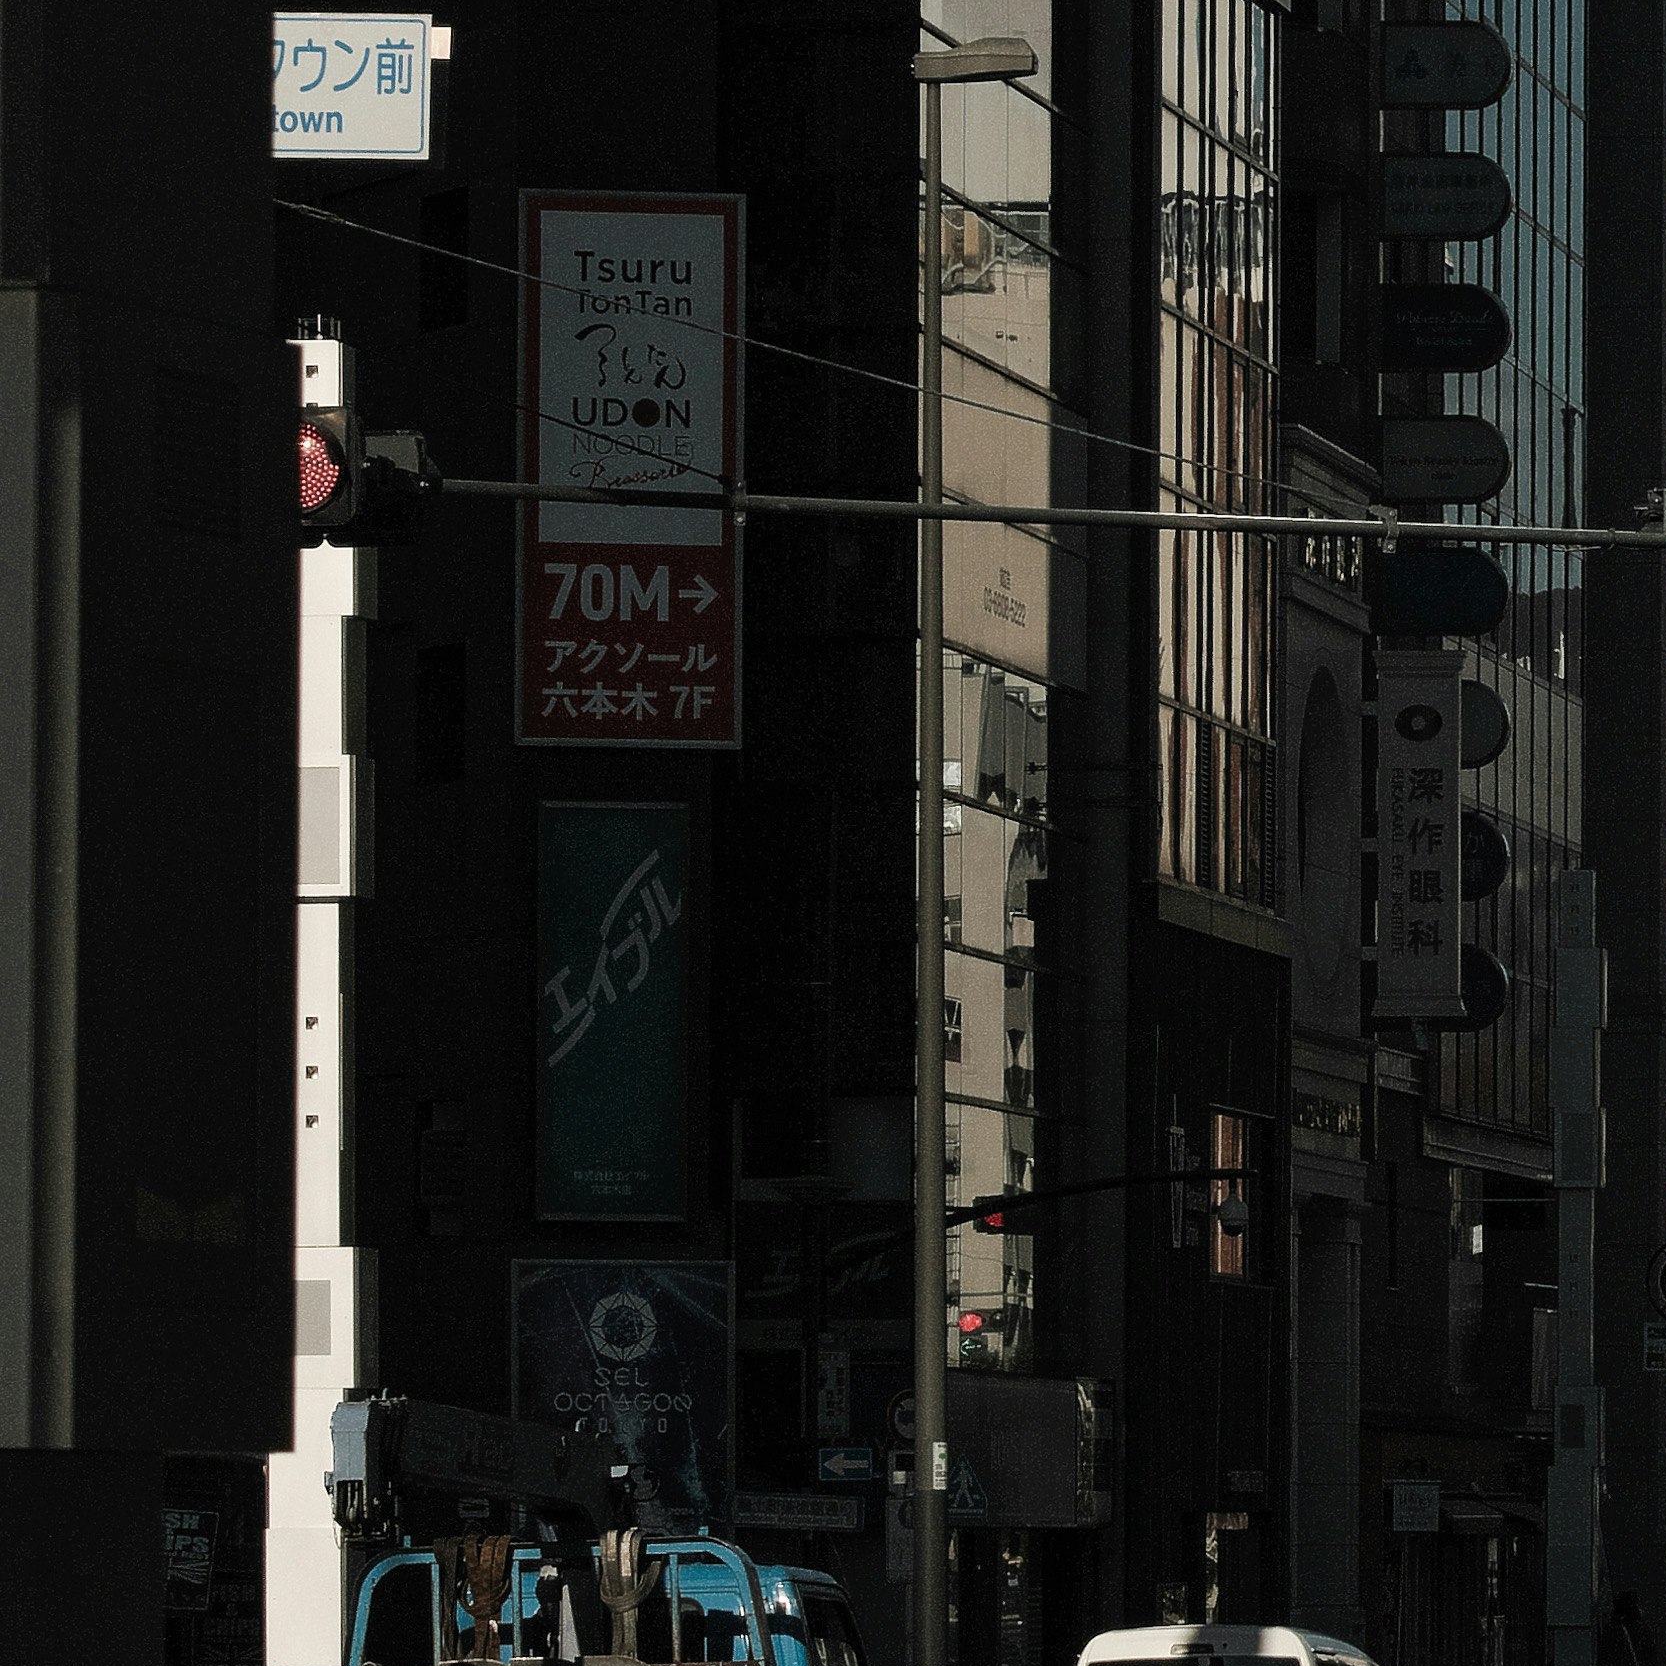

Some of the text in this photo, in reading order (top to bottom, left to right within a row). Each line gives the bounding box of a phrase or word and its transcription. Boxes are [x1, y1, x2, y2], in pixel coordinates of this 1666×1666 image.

[573, 250, 692, 285] Tsuru
[577, 289, 692, 317] TonTan
[572, 433, 692, 457] NOODLE
[543, 562, 670, 623] 70M
[544, 638, 718, 674] アクソール
[541, 681, 716, 721] 六本木 7F
[1391, 854, 1404, 882] EYE
[1408, 767, 1444, 957] 深作眼科
[545, 863, 682, 1045] エイブル
[594, 1367, 649, 1388] SEL
[554, 1391, 693, 1413] OCTAGON
